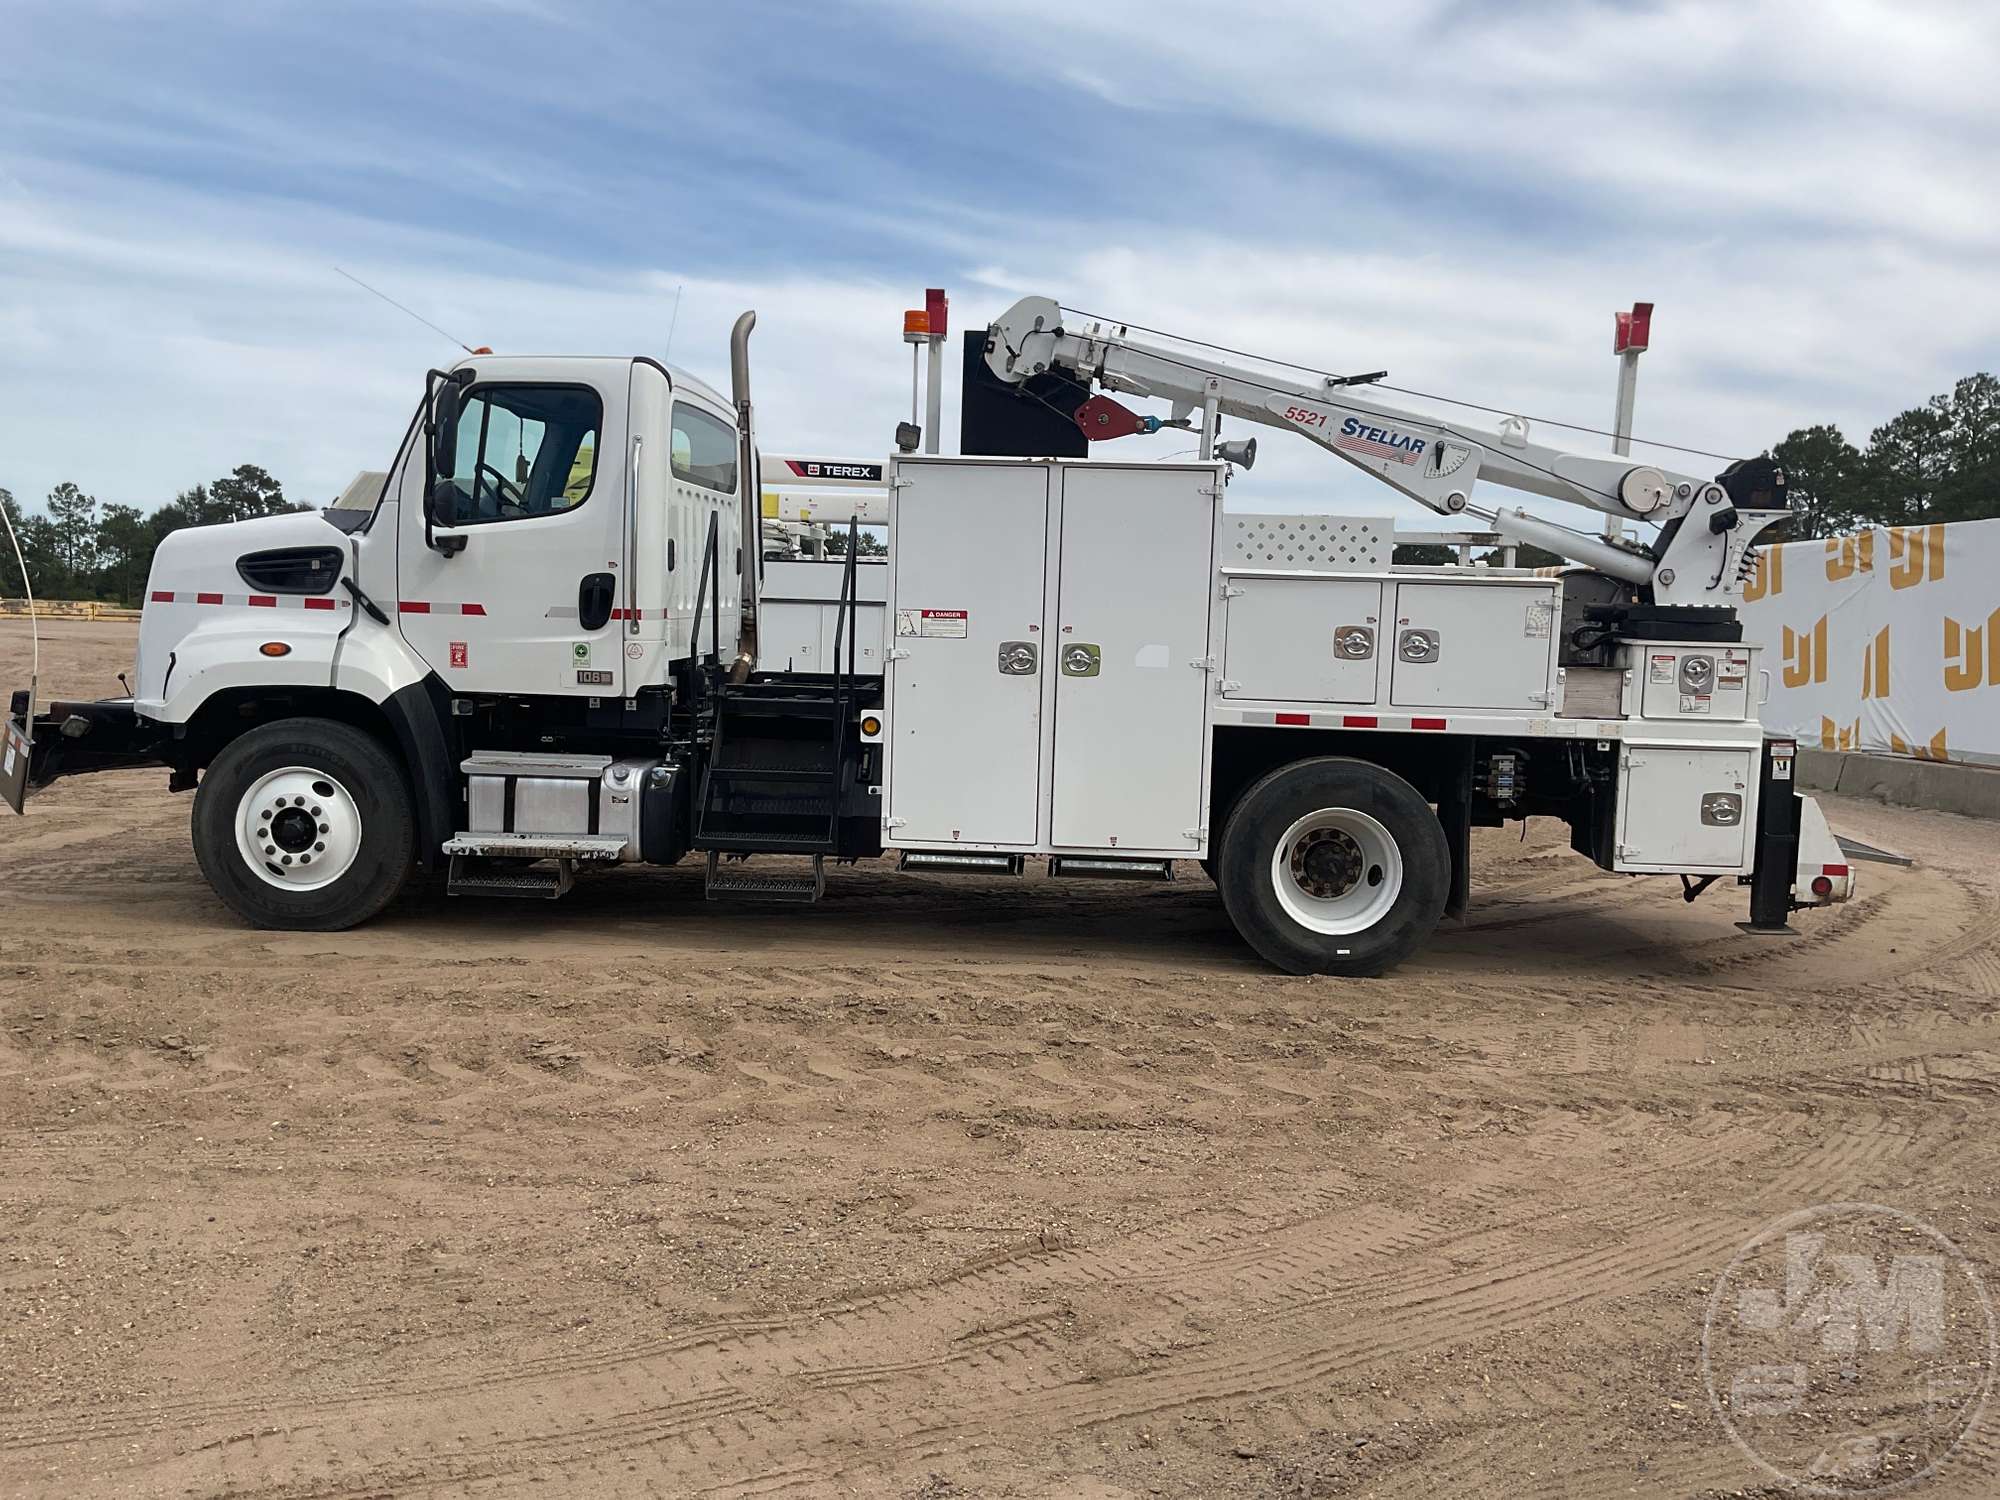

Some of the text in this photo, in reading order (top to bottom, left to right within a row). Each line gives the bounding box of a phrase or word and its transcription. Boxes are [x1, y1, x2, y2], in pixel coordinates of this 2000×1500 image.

[1284, 406, 1327, 428] 5521
[1340, 417, 1426, 454] STELLAR
[823, 465, 871, 478] TEREX
